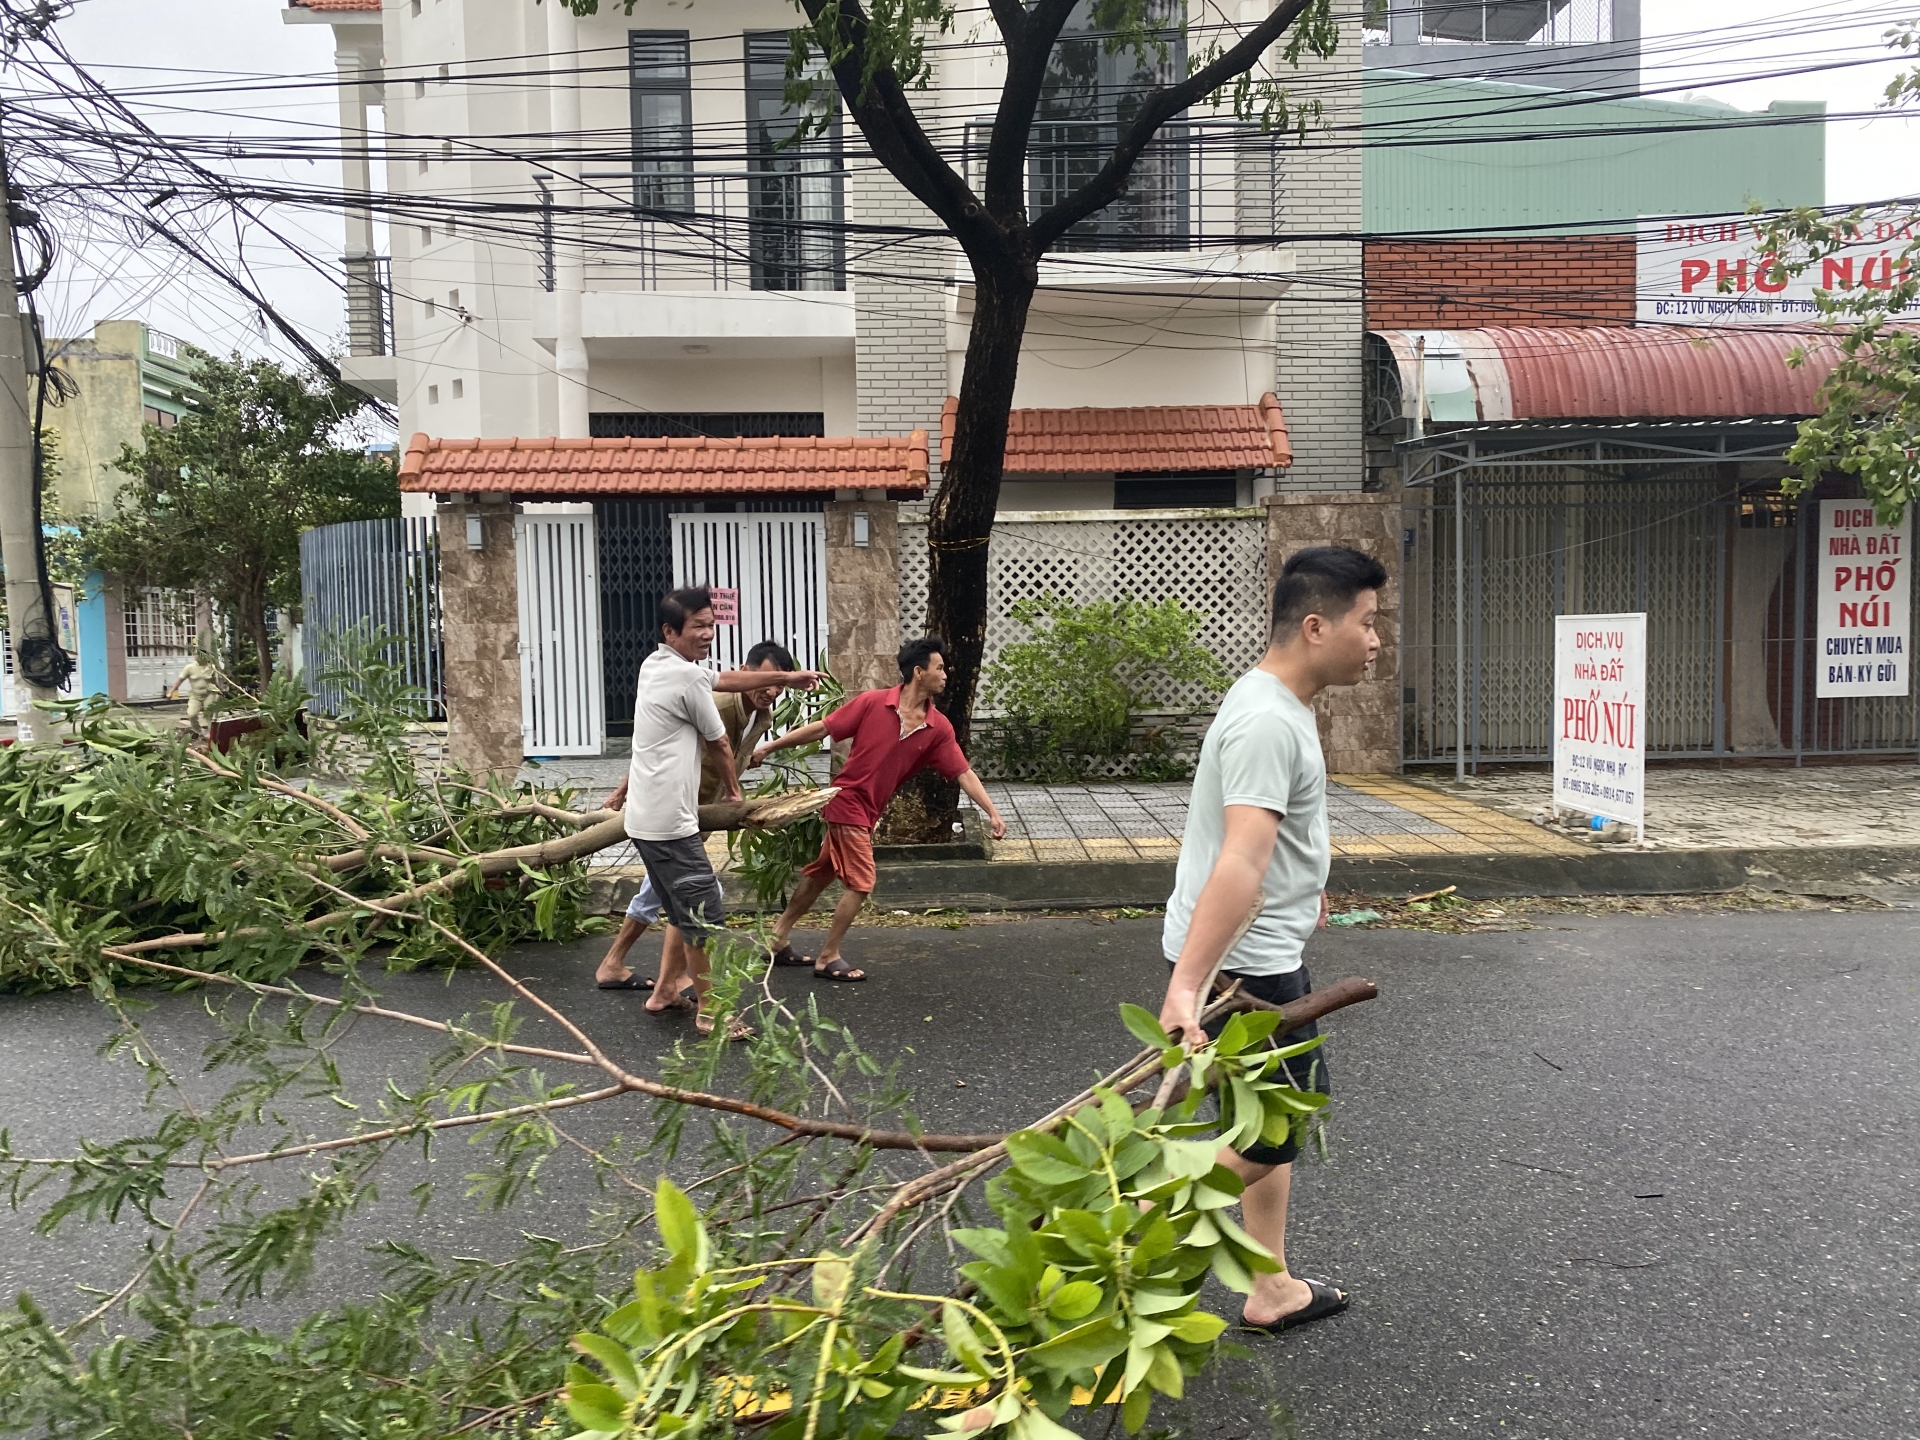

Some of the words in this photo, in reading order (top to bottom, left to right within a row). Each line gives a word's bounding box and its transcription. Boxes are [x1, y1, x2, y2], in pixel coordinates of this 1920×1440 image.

[1833, 509, 1873, 531] DỊCH
[1829, 533, 1861, 555] NHÀ
[1866, 533, 1902, 554] ĐẤT
[1835, 558, 1902, 592] PHỐ
[1839, 594, 1890, 628] NÚI
[1606, 631, 1624, 652] VỤ
[1826, 634, 1873, 655] CHUYÊN
[1876, 636, 1903, 654] MUA
[1574, 656, 1598, 681] NHÀ
[1600, 657, 1625, 682] ĐẤT
[1563, 688, 1601, 744] PHỐ
[1602, 691, 1636, 749] NÚI
